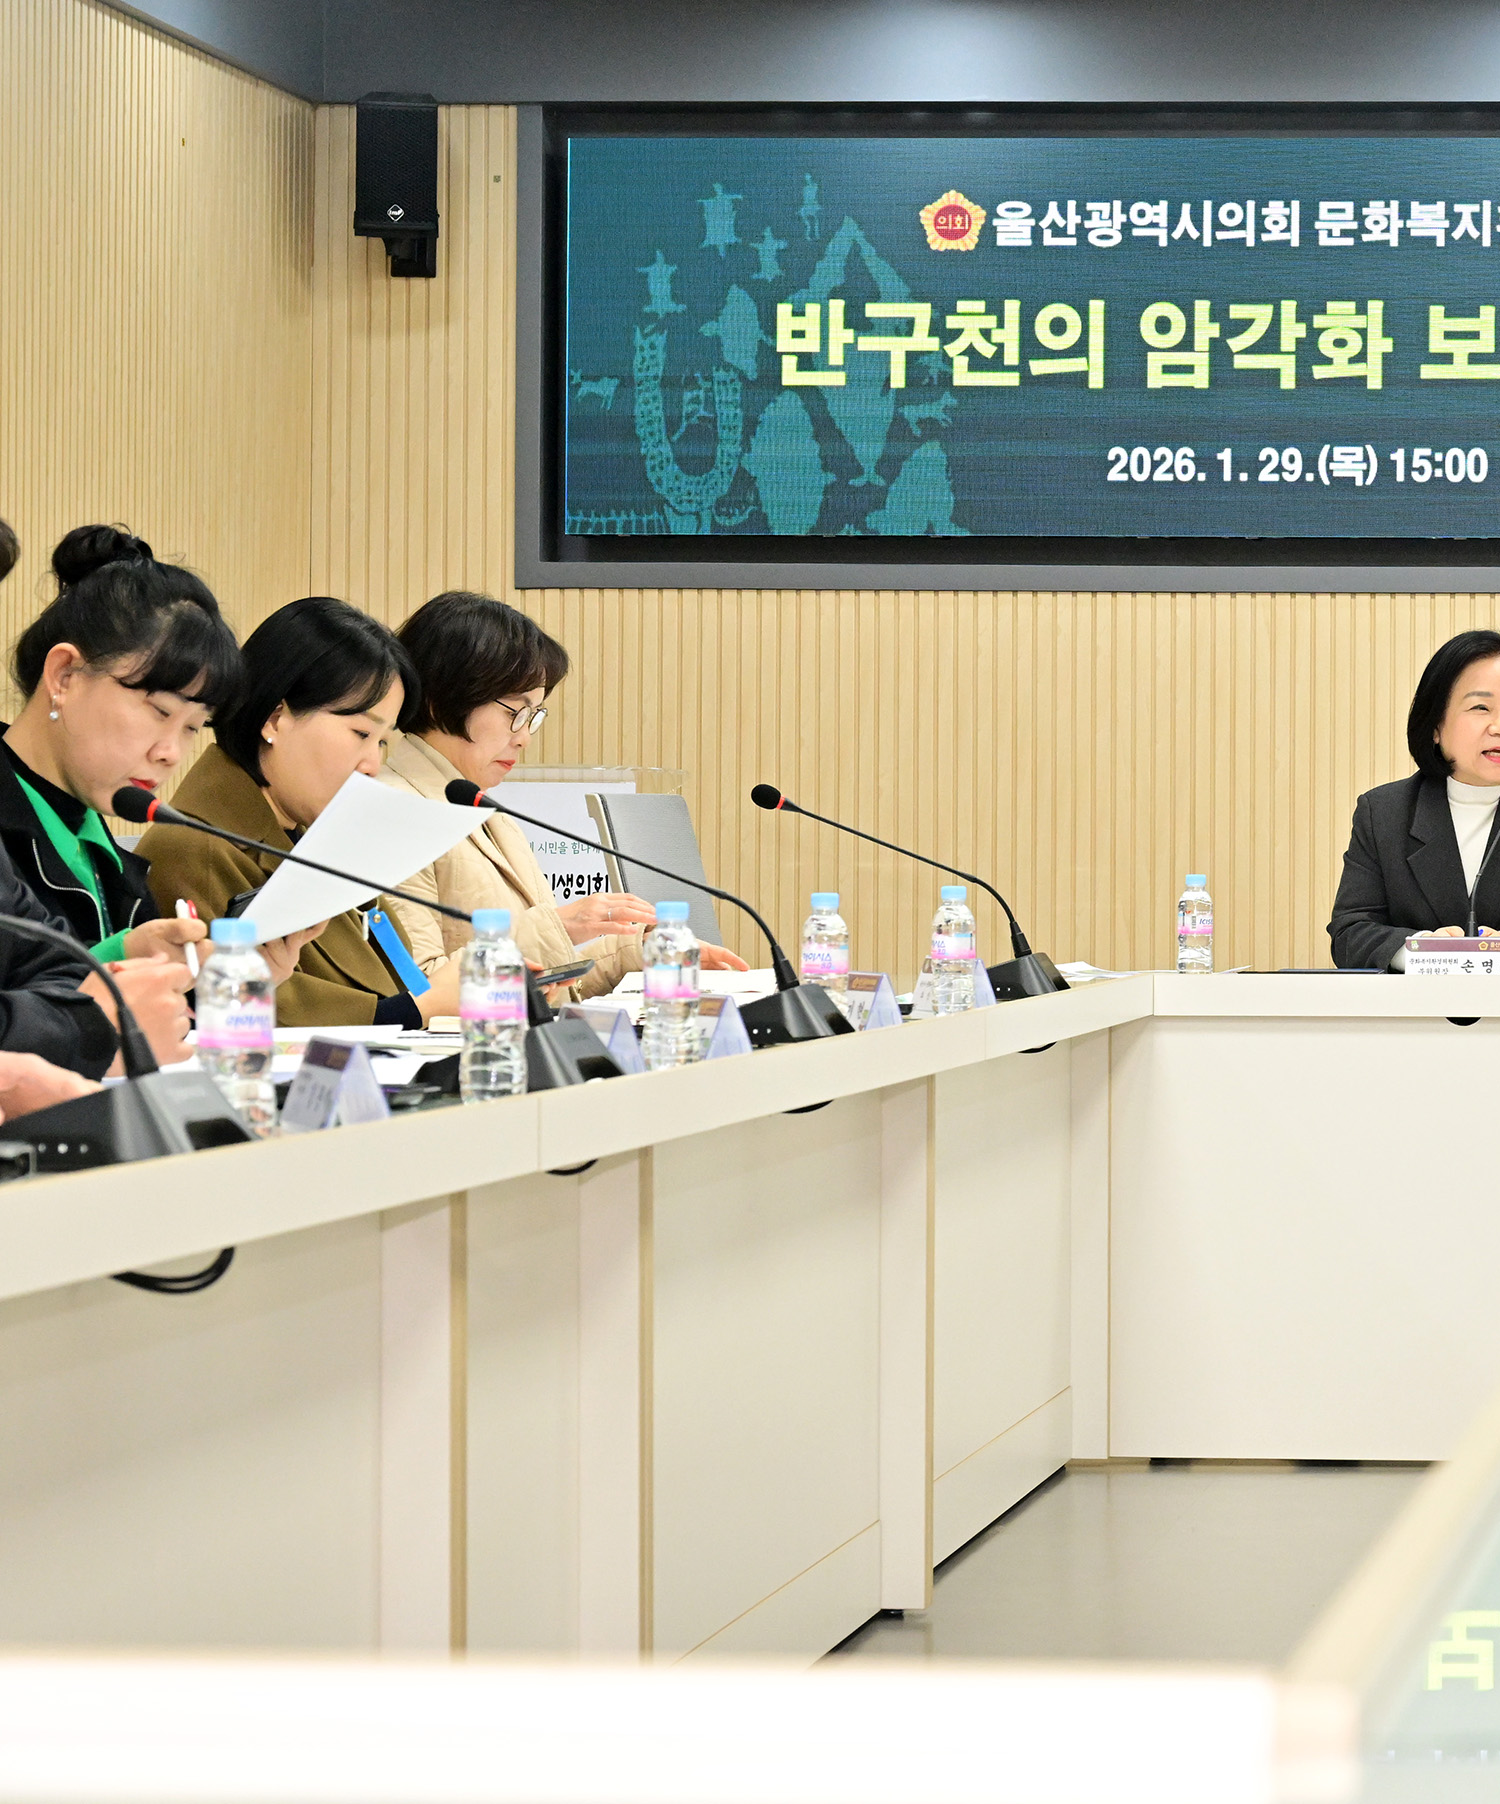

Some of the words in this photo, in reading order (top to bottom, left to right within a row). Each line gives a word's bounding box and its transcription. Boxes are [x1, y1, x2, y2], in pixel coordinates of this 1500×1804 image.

[936, 213, 969, 230] 의회
[992, 199, 1301, 248] 울산광역시의회
[775, 298, 1106, 391] 반구천의
[1138, 298, 1395, 391] 암각화
[1107, 446, 1207, 482] 2026.
[1216, 446, 1248, 482] 1.
[1258, 444, 1378, 487] 29.(목)
[1389, 447, 1489, 483] 15:00
[537, 841, 568, 855] 시민을
